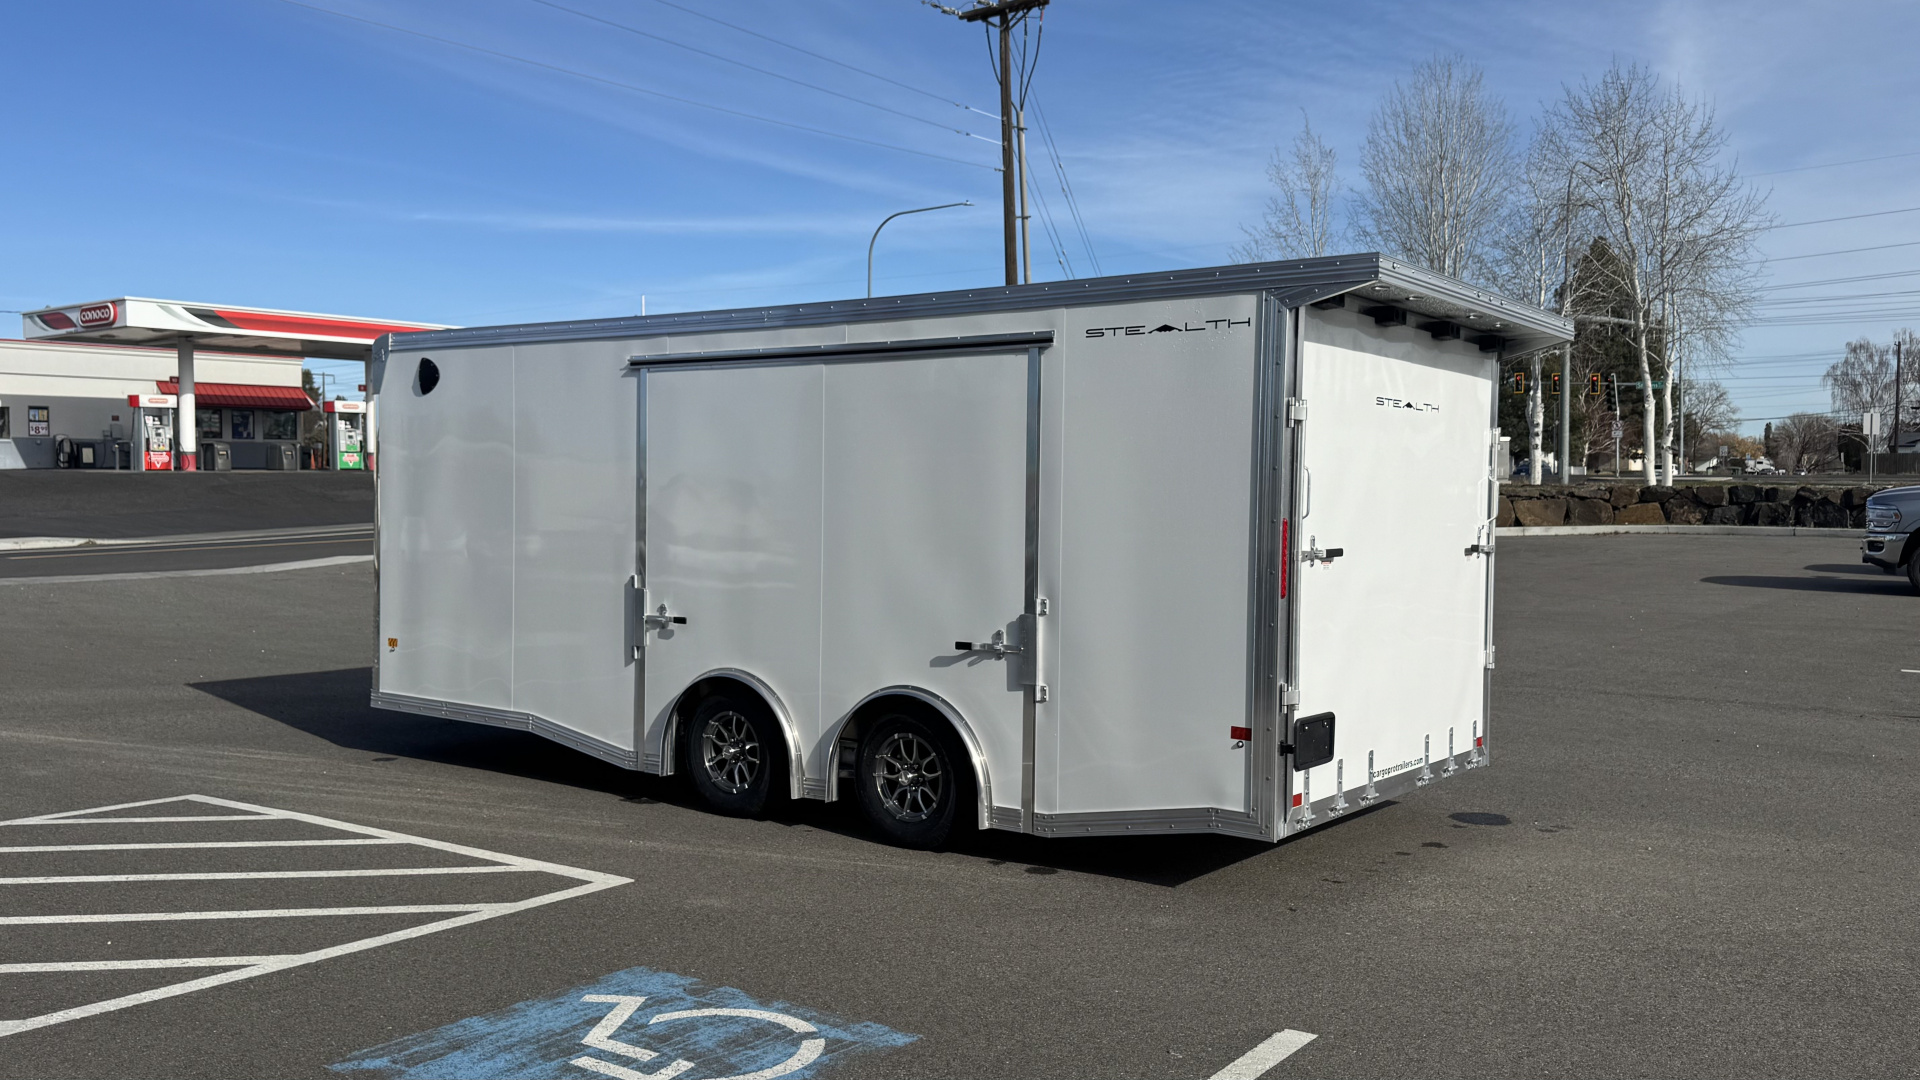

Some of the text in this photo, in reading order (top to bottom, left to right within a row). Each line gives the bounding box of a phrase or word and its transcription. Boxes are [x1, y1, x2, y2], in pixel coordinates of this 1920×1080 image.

[1085, 317, 1251, 339] STEALTH
[1376, 396, 1440, 413] STEALTH
[1372, 757, 1423, 778] cargoprotrailers.com
